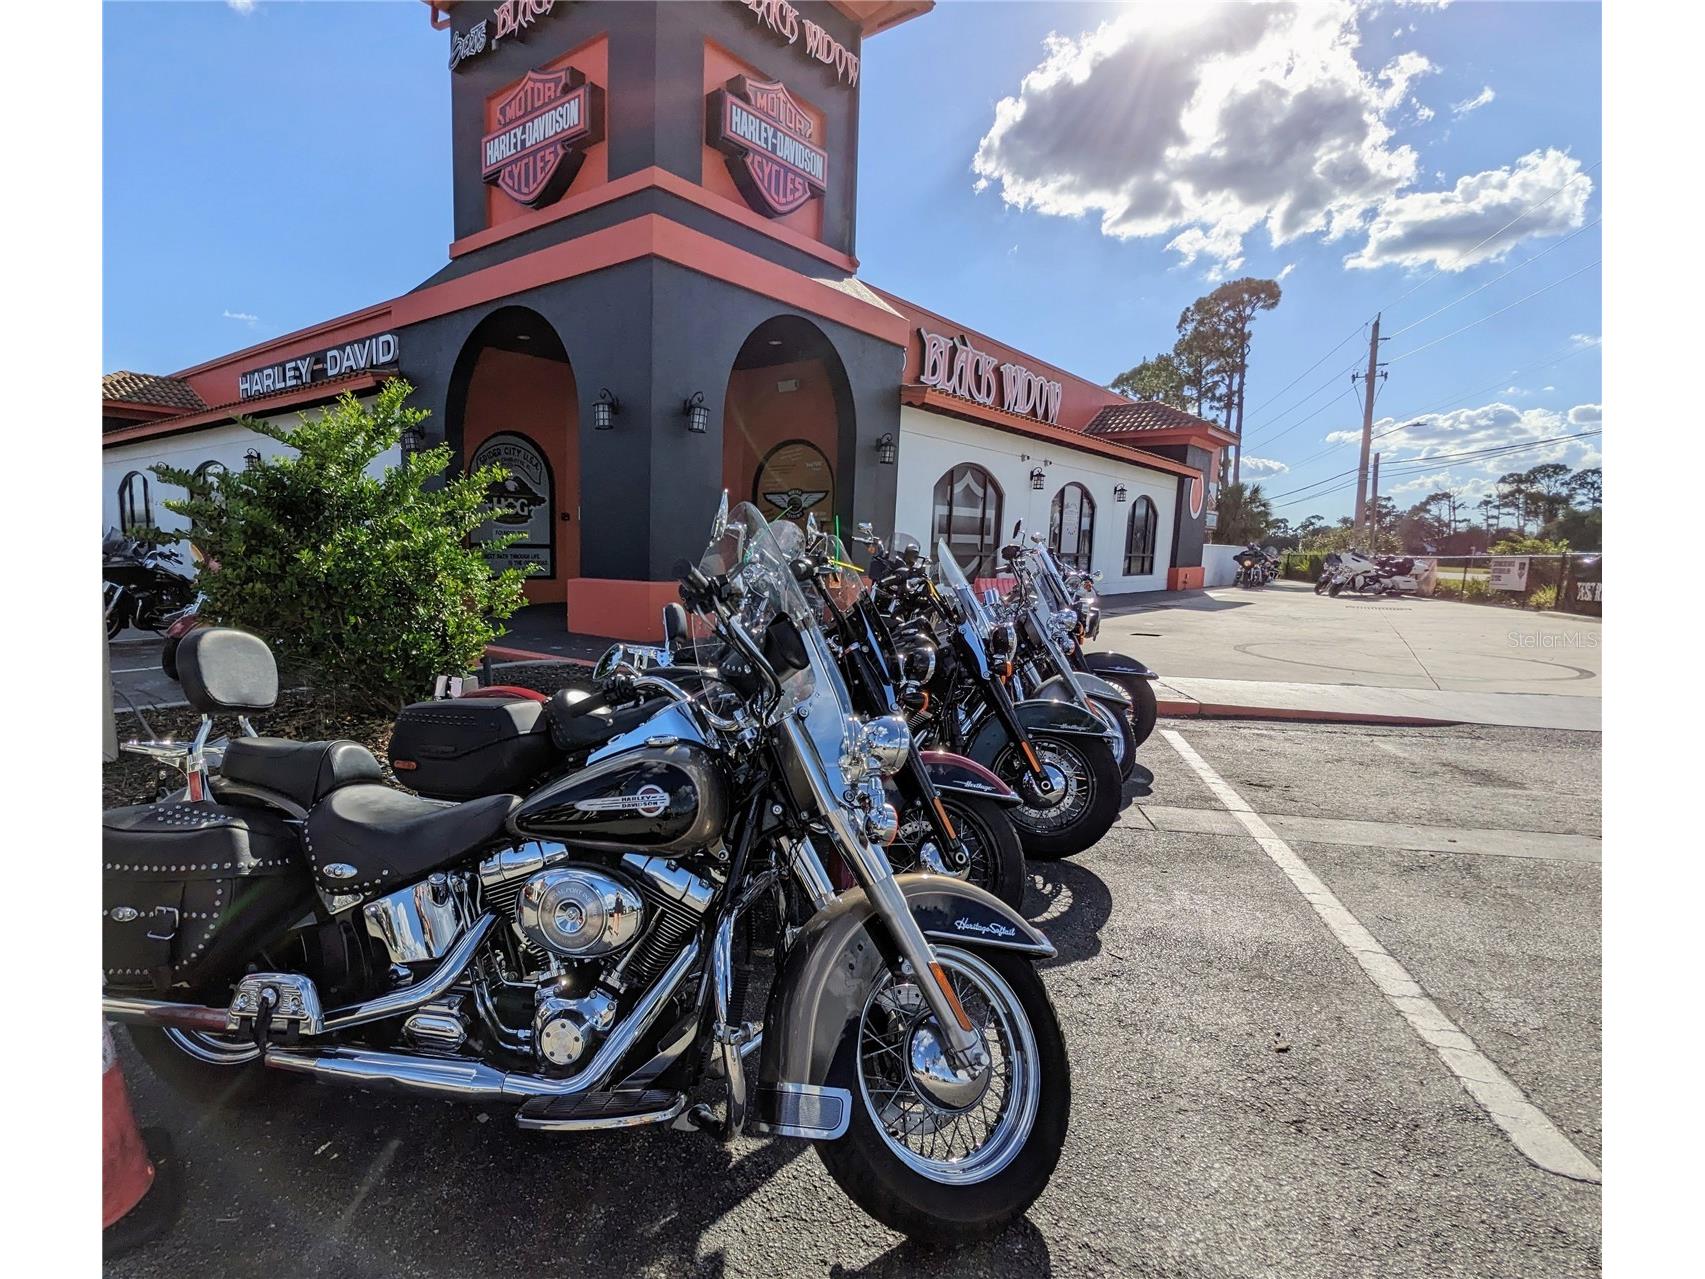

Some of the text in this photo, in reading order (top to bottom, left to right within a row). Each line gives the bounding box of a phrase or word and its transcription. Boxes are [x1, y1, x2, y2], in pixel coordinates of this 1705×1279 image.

[802, 19, 860, 88] WIDOW
[505, 80, 555, 122] MOTOR
[756, 91, 807, 136] MOTOR
[486, 97, 579, 167] HARLEY-DAVIDSON
[731, 104, 824, 181] HARLEY-DAVIDSON
[504, 146, 555, 194] CYCLES
[753, 155, 804, 204] CYCLES
[920, 328, 1062, 423] BLACK WIDOW
[504, 446, 522, 457] CITY
[964, 780, 993, 792] Heritage
[954, 917, 1016, 936] Heritage Softail
